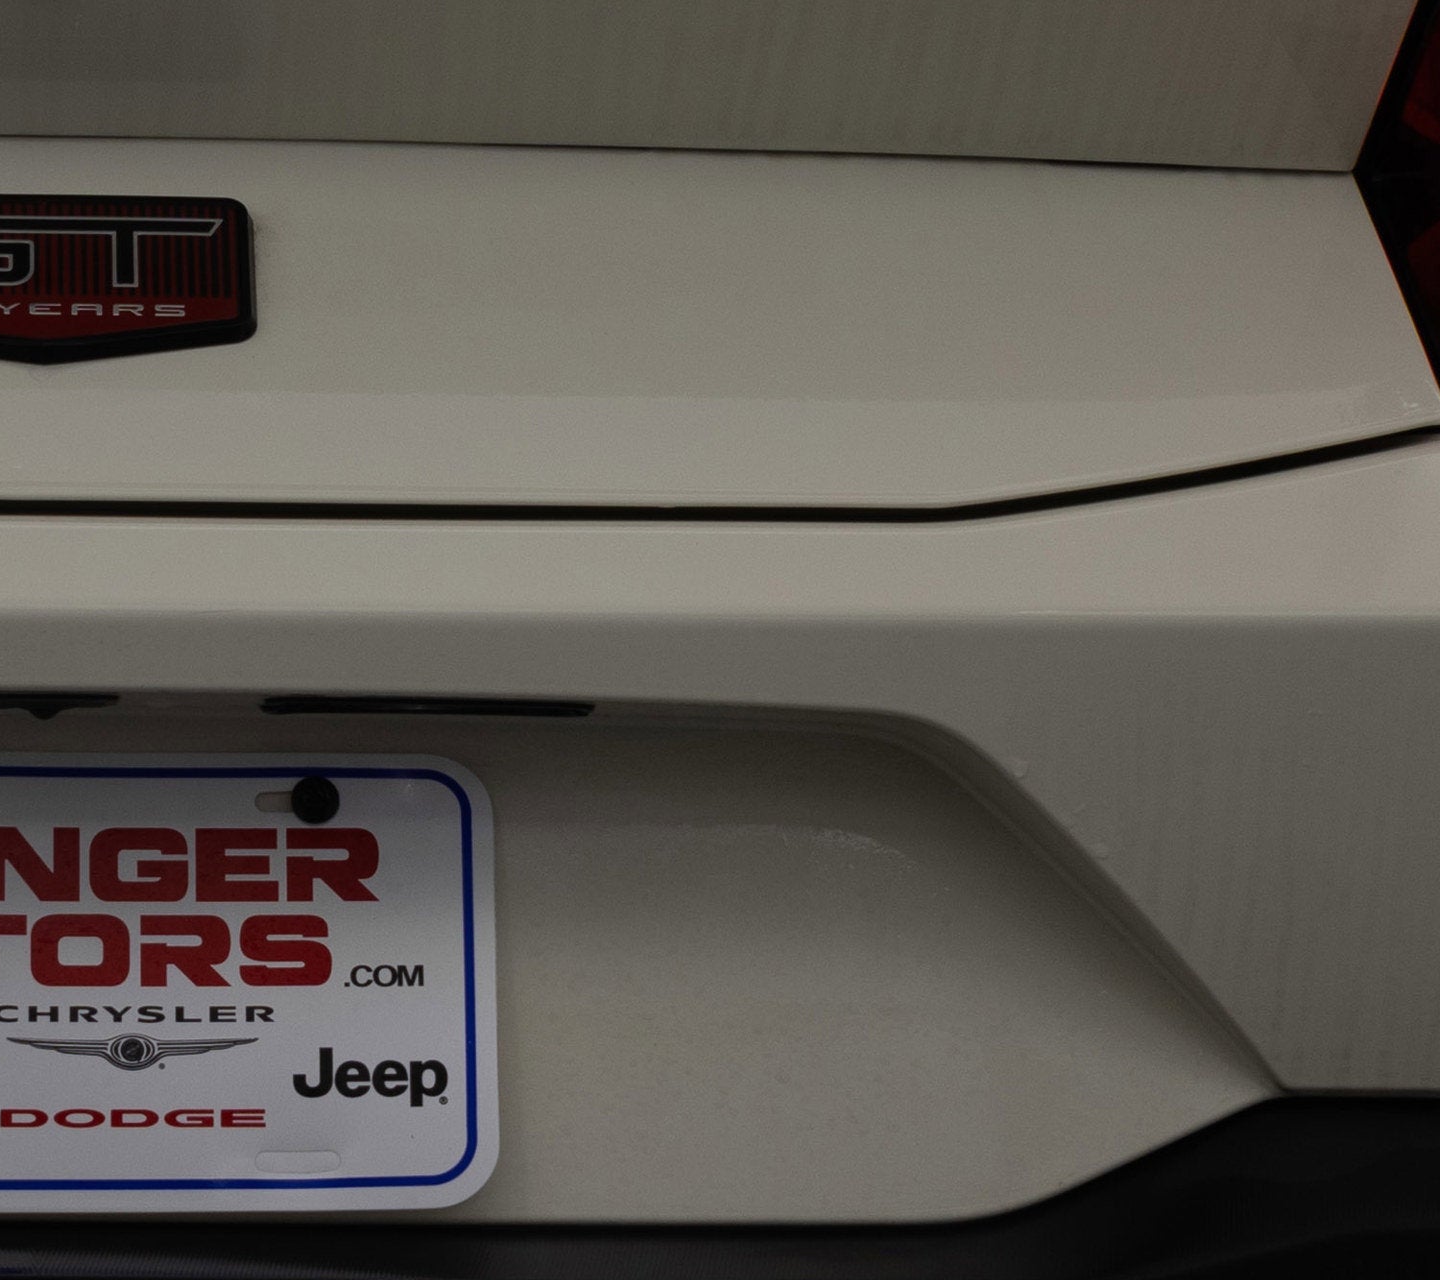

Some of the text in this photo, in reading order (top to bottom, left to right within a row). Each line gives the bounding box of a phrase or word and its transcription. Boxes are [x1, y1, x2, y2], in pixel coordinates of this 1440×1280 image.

[343, 964, 425, 988] .COM
[292, 1046, 449, 1108] Jeep
[0, 1108, 267, 1128] DODGE
